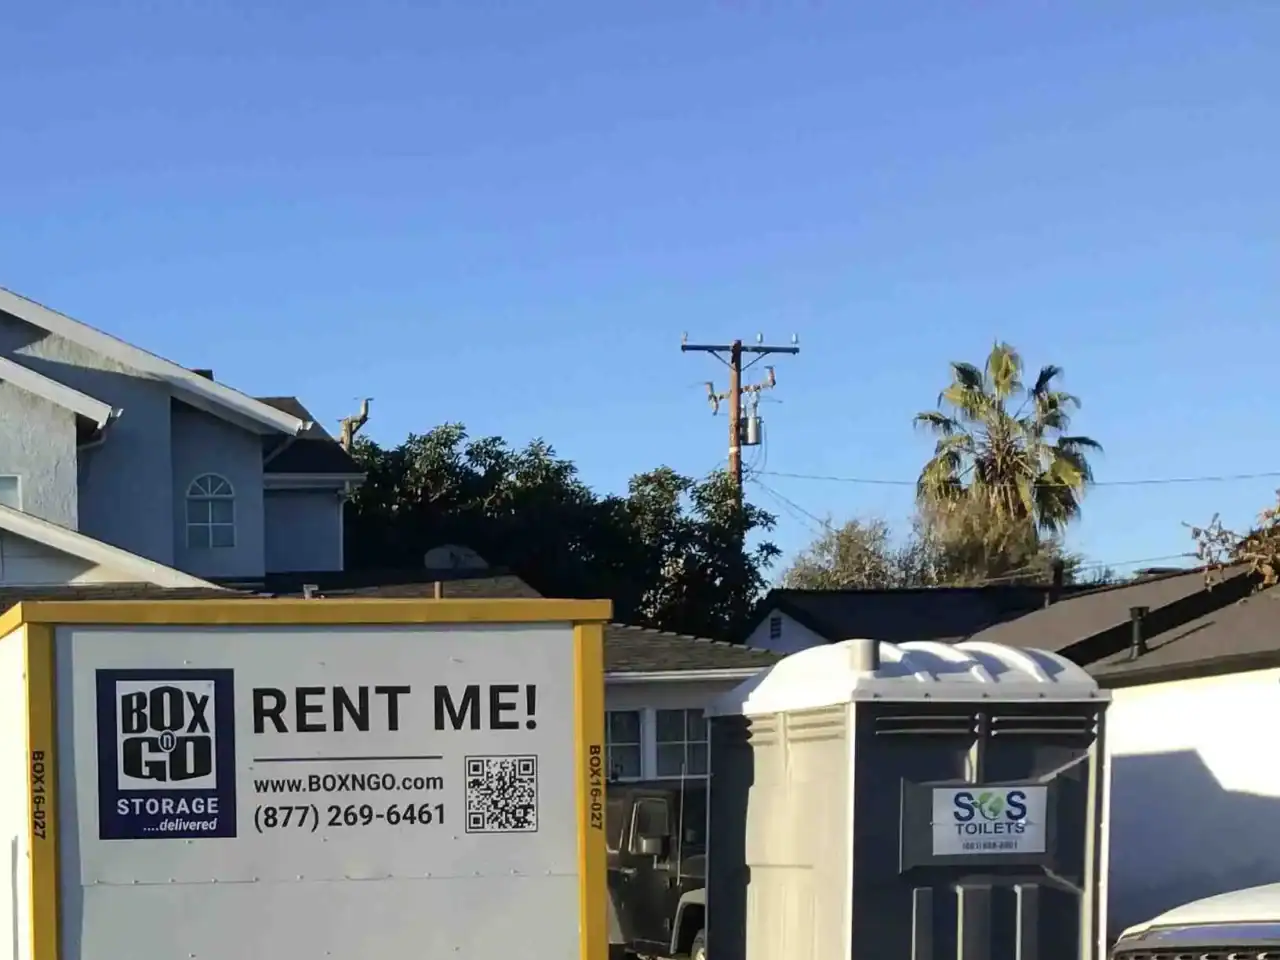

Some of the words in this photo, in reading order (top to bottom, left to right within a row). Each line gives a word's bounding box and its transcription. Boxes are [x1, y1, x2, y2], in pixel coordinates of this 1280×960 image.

[120, 685, 211, 734] BOX
[252, 684, 412, 733] RENT
[433, 684, 538, 730] ME!
[122, 735, 213, 782] GO
[32, 750, 47, 841] BOX16-027
[254, 773, 444, 793] www.BOXNGO.com
[589, 744, 603, 830] BOX16-027
[116, 797, 220, 816] STORAGE
[253, 804, 320, 834] (877)
[326, 803, 445, 828] 269-6461
[953, 791, 1027, 822] SOS
[955, 822, 1025, 835] TOILETS
